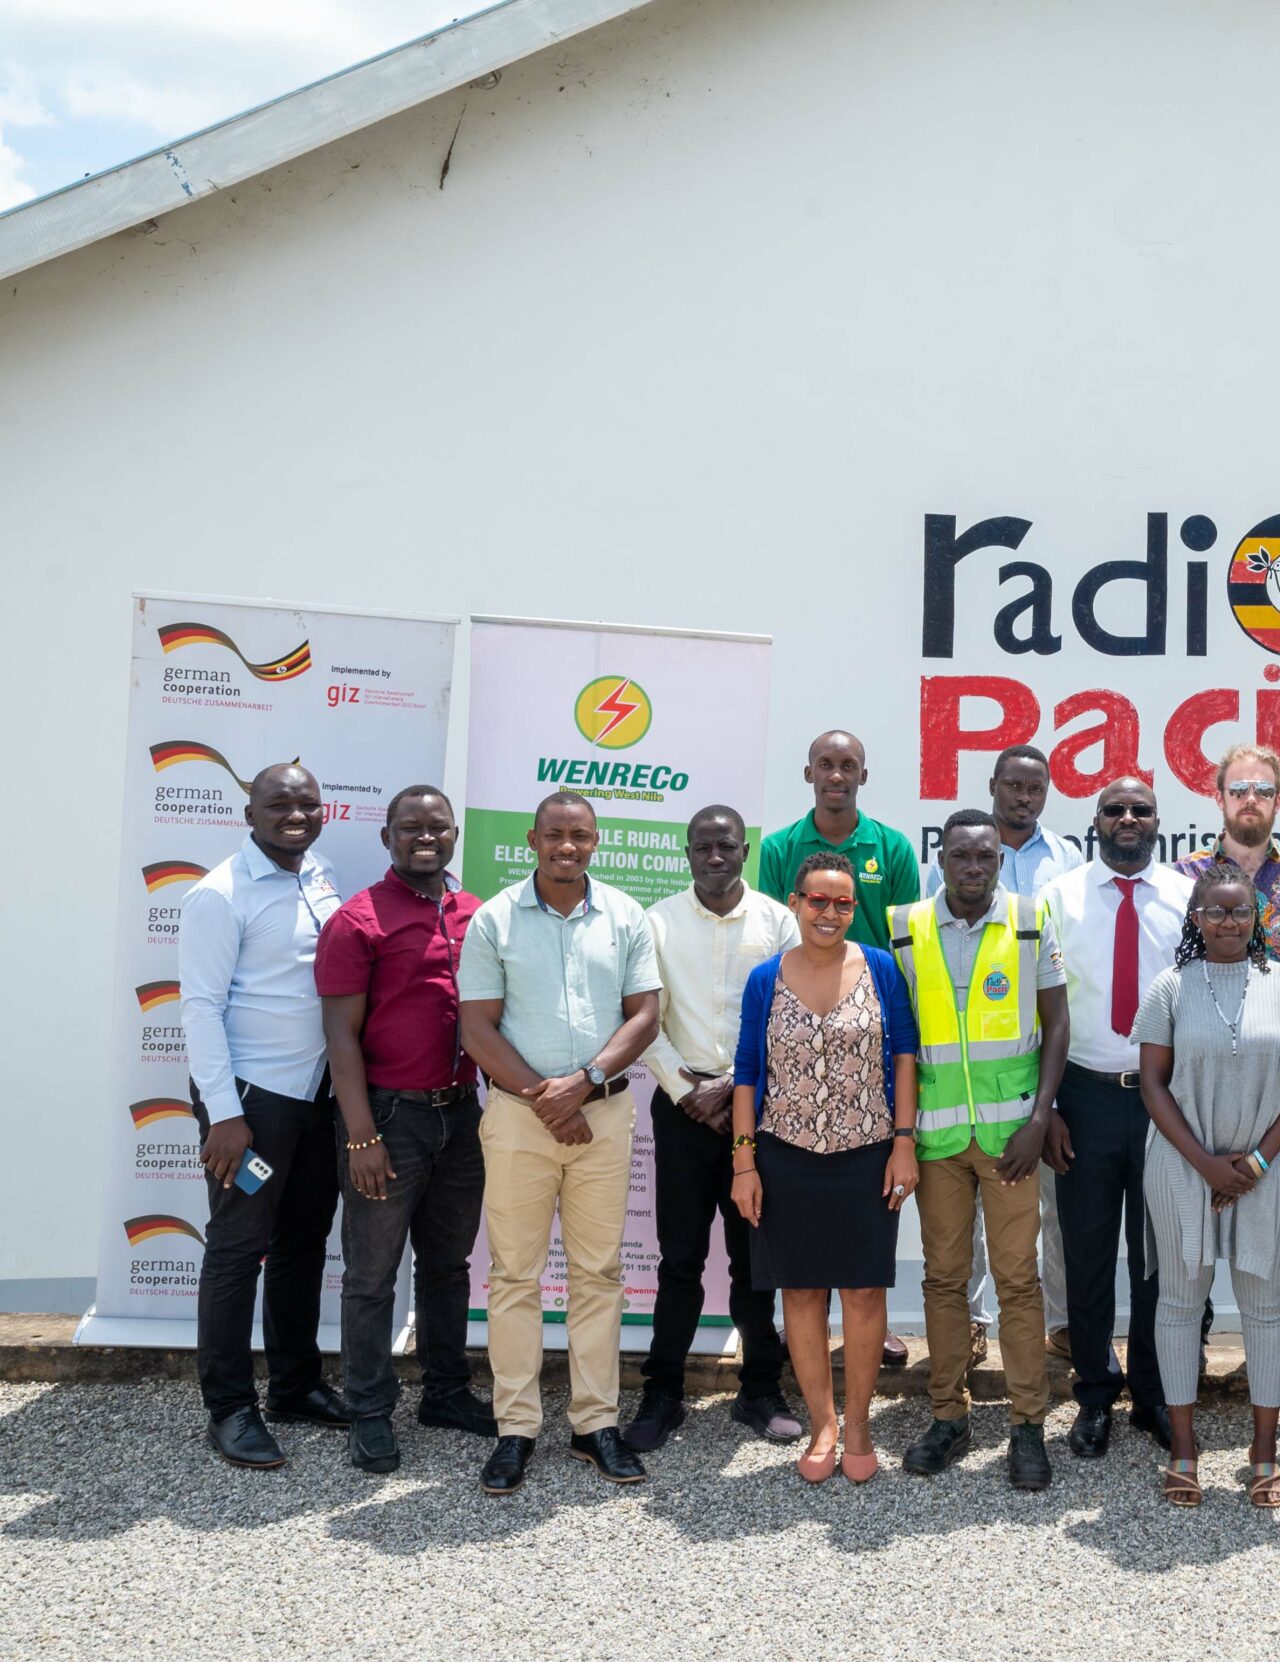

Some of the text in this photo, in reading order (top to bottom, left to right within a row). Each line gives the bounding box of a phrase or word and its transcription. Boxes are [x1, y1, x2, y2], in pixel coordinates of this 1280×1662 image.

[163, 667, 231, 682] german
[331, 665, 391, 679] Implemented by
[163, 683, 241, 697] cooperation
[327, 683, 361, 707] giz
[162, 696, 273, 711] DEUTSCHE ZUSAMMENARBEIT
[537, 758, 690, 791] WENRECo
[155, 786, 223, 801] german
[322, 782, 382, 795] Implemented by
[613, 789, 641, 800] West
[641, 791, 664, 802] Nile
[155, 803, 233, 815] cooperation
[154, 816, 194, 825] DEUTSCHE
[627, 831, 681, 850] RURAL
[136, 1158, 205, 1170] cooperatio
[625, 1252, 644, 1260] Arua
[646, 1253, 661, 1262] city
[131, 1260, 196, 1274] german
[130, 1275, 200, 1286] cooperatio
[130, 1288, 169, 1296] DEUTSCHE
